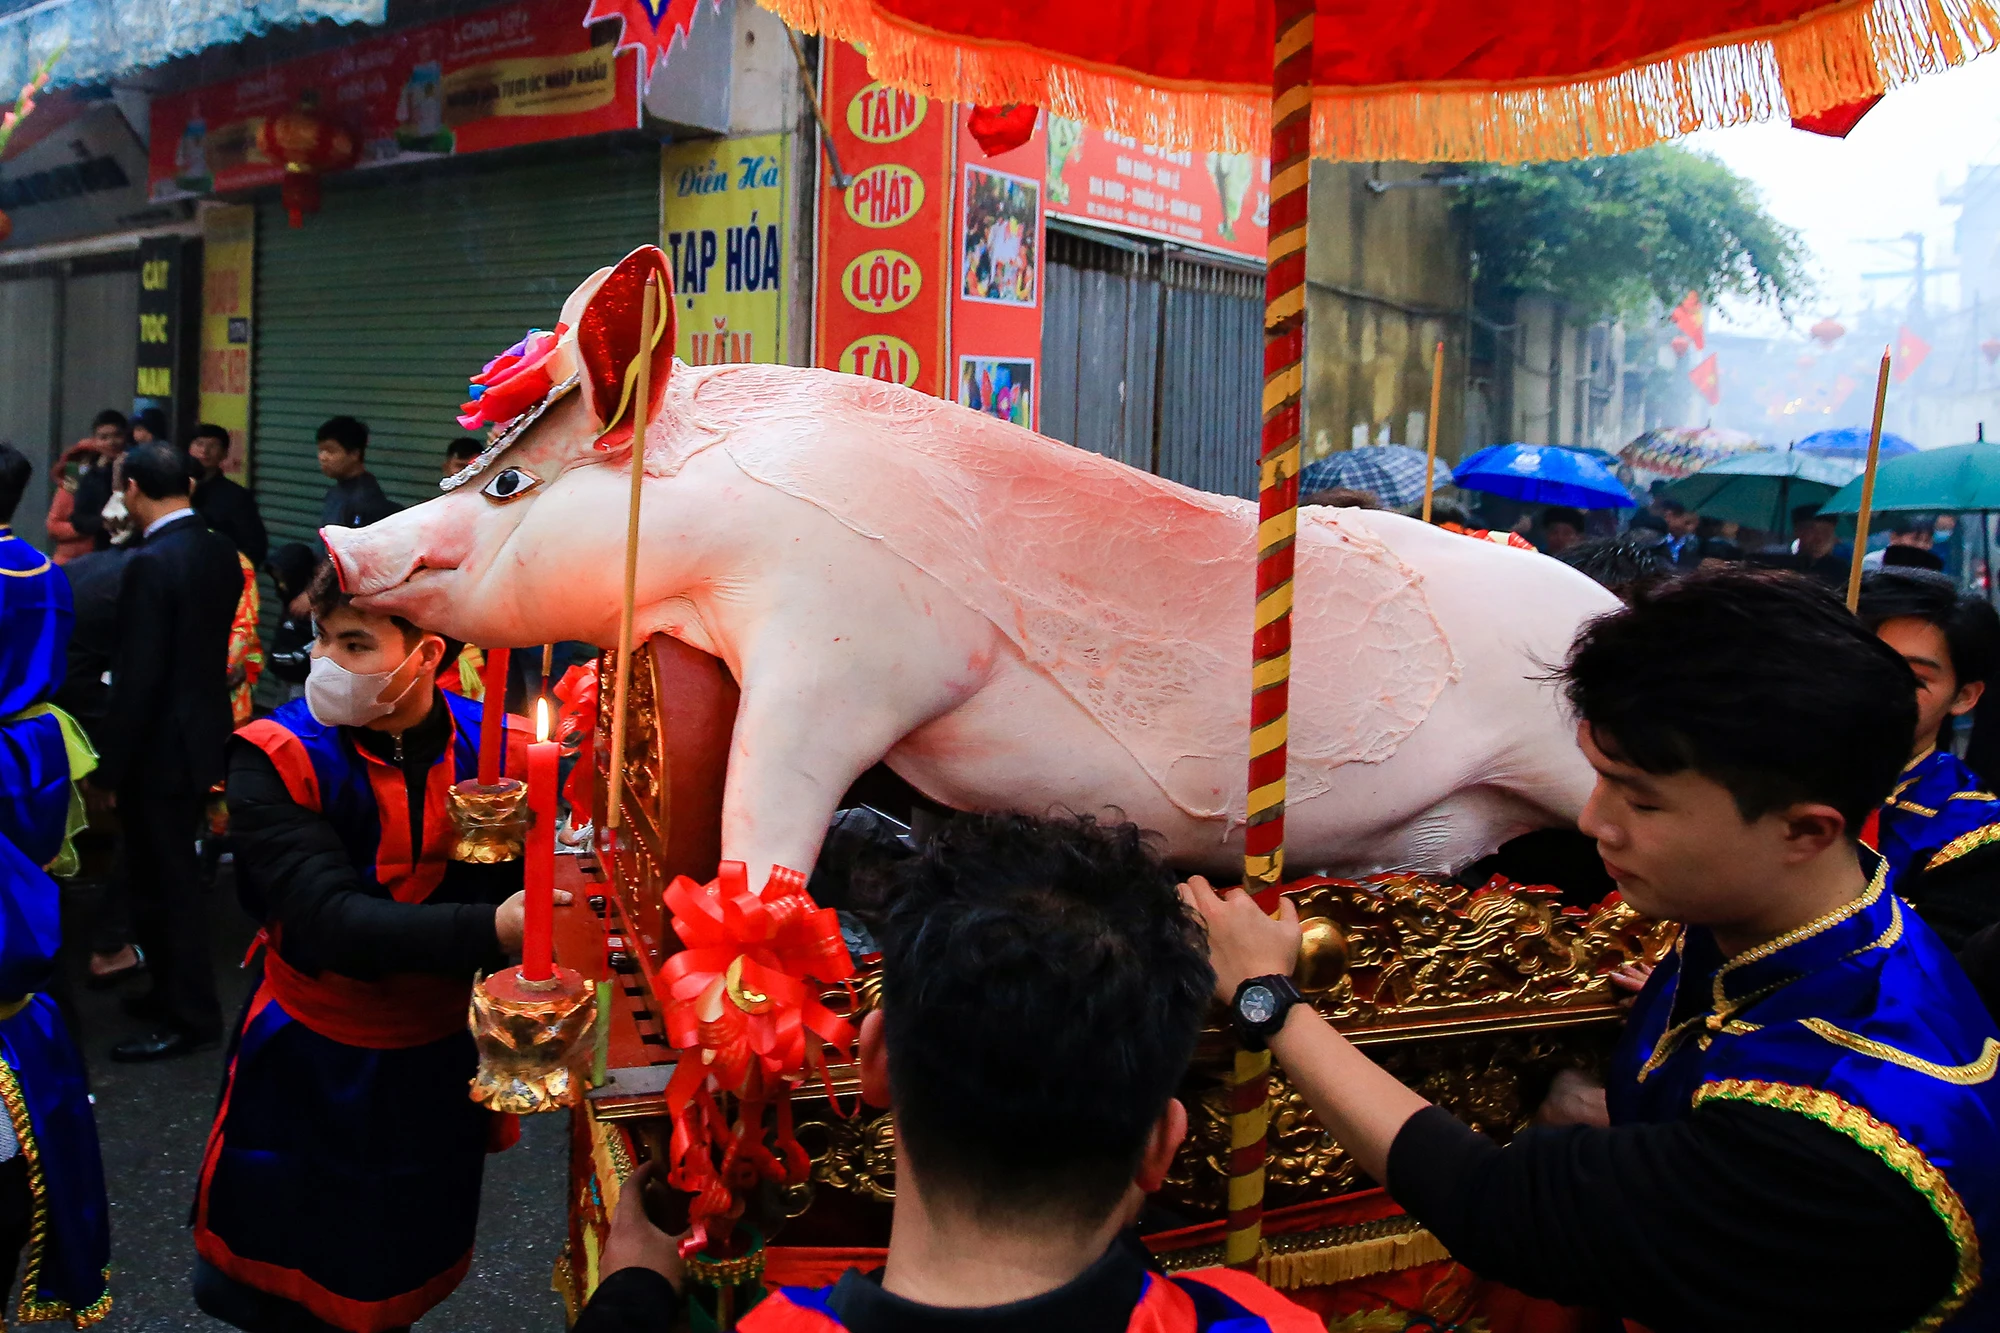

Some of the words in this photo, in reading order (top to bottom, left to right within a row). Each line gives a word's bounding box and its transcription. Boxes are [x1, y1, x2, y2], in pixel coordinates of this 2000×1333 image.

[737, 155, 780, 190] Hà
[853, 169, 913, 223] PHÁT
[668, 229, 717, 309] TẠP
[725, 210, 780, 292] HÓA
[852, 255, 911, 307] LỘC
